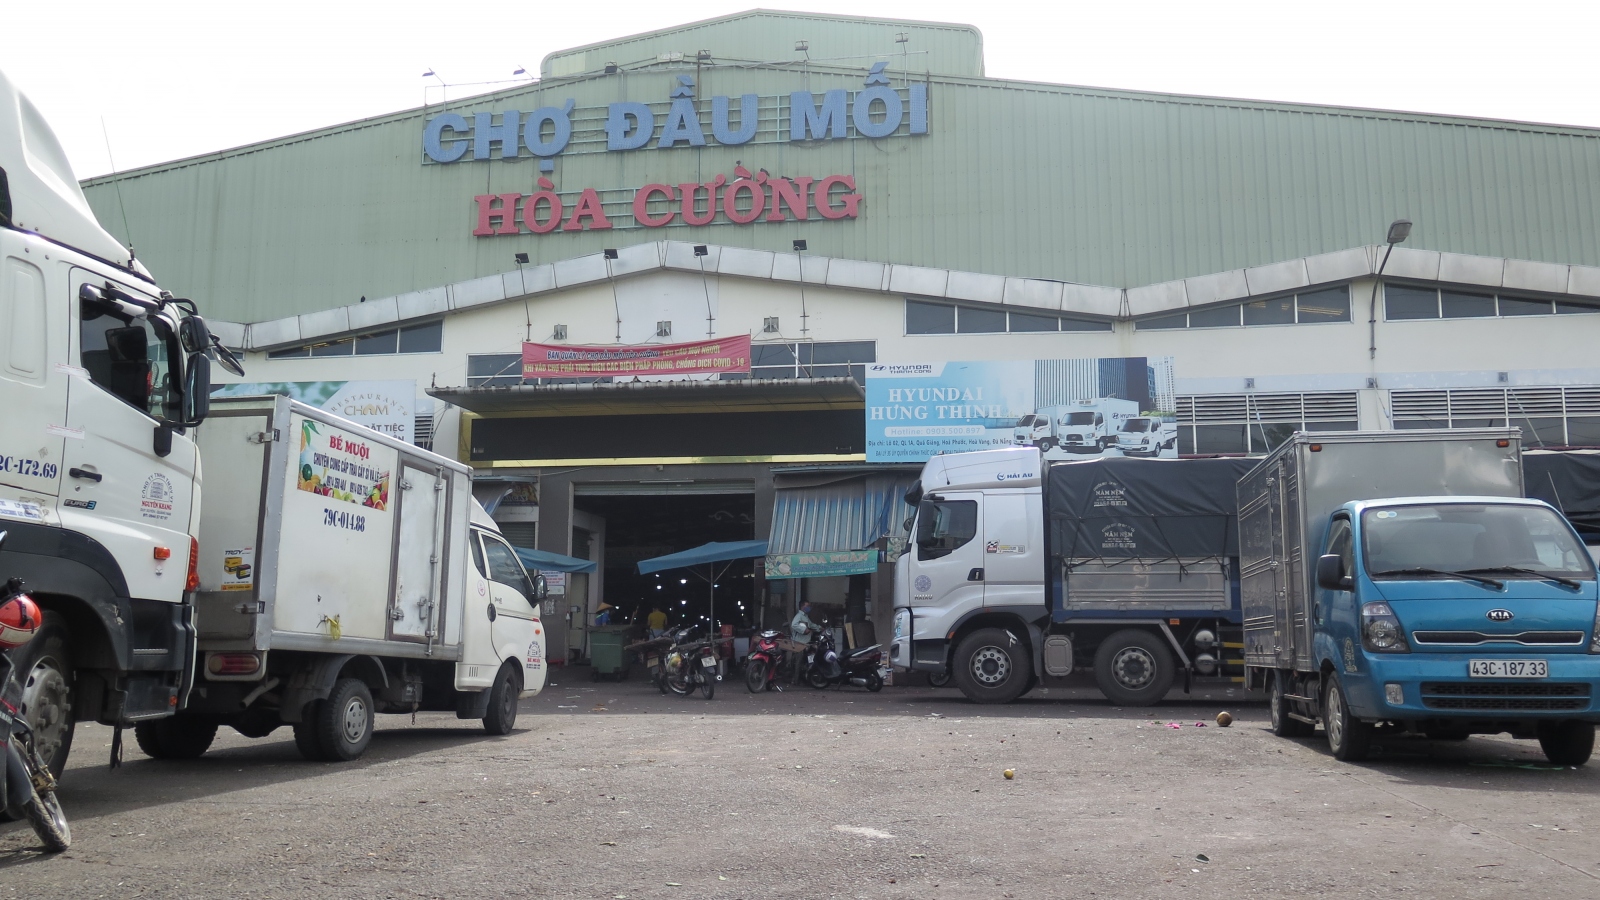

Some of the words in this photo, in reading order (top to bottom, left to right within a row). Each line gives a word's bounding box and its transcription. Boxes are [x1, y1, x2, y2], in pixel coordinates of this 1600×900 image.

[423, 98, 576, 172] CHỢ
[605, 75, 759, 151] ĐẦU
[789, 61, 928, 141] MỐI
[473, 177, 613, 237] HÒA
[632, 164, 862, 228] CƯỜNG
[547, 350, 560, 361] BAN
[560, 349, 577, 361] QUẢN
[524, 363, 534, 373] KHI
[547, 363, 560, 374] CHỢ
[619, 360, 634, 373] BIỆN
[635, 358, 651, 371] PHÁP
[652, 357, 674, 371] PHÒNG,
[675, 357, 697, 369] CHỐNG
[697, 358, 712, 370] DỊCH
[713, 358, 731, 367] COVID
[736, 357, 745, 367] 19
[888, 387, 984, 402] HYUNDAI
[870, 403, 929, 421] HƯNG
[936, 403, 1004, 423] THỊNH
[384, 422, 405, 434] TIỆC
[926, 427, 981, 435] 0903.500.897
[329, 434, 343, 451] BÉ
[345, 441, 370, 461] MUỘI
[324, 508, 366, 532] 79C-014.88
[1491, 611, 1509, 620] KIA
[1472, 662, 1546, 676] 43C-187.33
